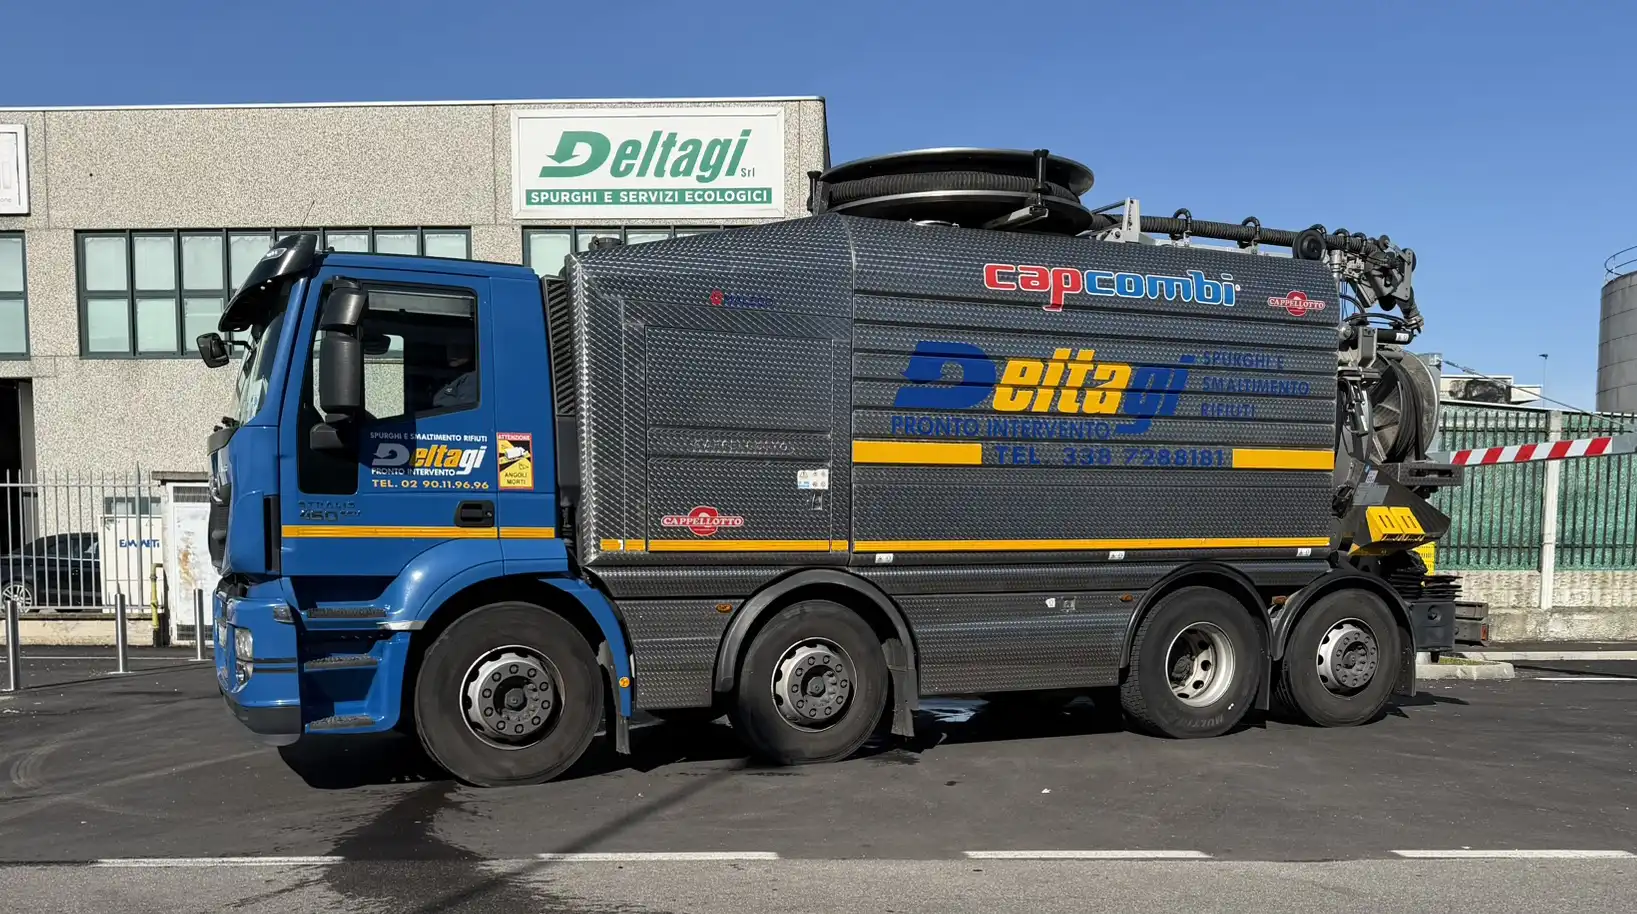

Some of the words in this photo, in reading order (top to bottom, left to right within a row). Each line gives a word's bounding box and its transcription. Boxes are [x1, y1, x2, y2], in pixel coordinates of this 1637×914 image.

[538, 129, 752, 183] Deltagi
[741, 168, 755, 177] Srl
[531, 191, 597, 203] SPURGHI
[604, 191, 613, 202] E
[620, 190, 679, 202] SERVIZI
[685, 190, 767, 202] ECOLOGICI
[983, 263, 1236, 312] capcombi
[1269, 298, 1324, 309] CAPPELLOTTO
[1203, 350, 1271, 367] SPURGHI
[894, 341, 1195, 434] Deltagi
[1203, 376, 1310, 395] SMALTIMENTO
[1201, 402, 1256, 418] RIFIUTI
[891, 416, 979, 436] PRONTO
[987, 419, 1110, 439] INTERVENTO
[410, 433, 462, 441] SMALTIMENTO
[371, 443, 488, 475] Deltagi
[1063, 447, 1112, 465] 338
[1124, 449, 1224, 466] 7288181
[407, 468, 455, 476] INTERVENTO
[372, 479, 398, 488] TEL.
[401, 480, 418, 488] 02
[422, 480, 489, 489] 90.11.96.96
[663, 517, 743, 525] CAPPELLOTTO
